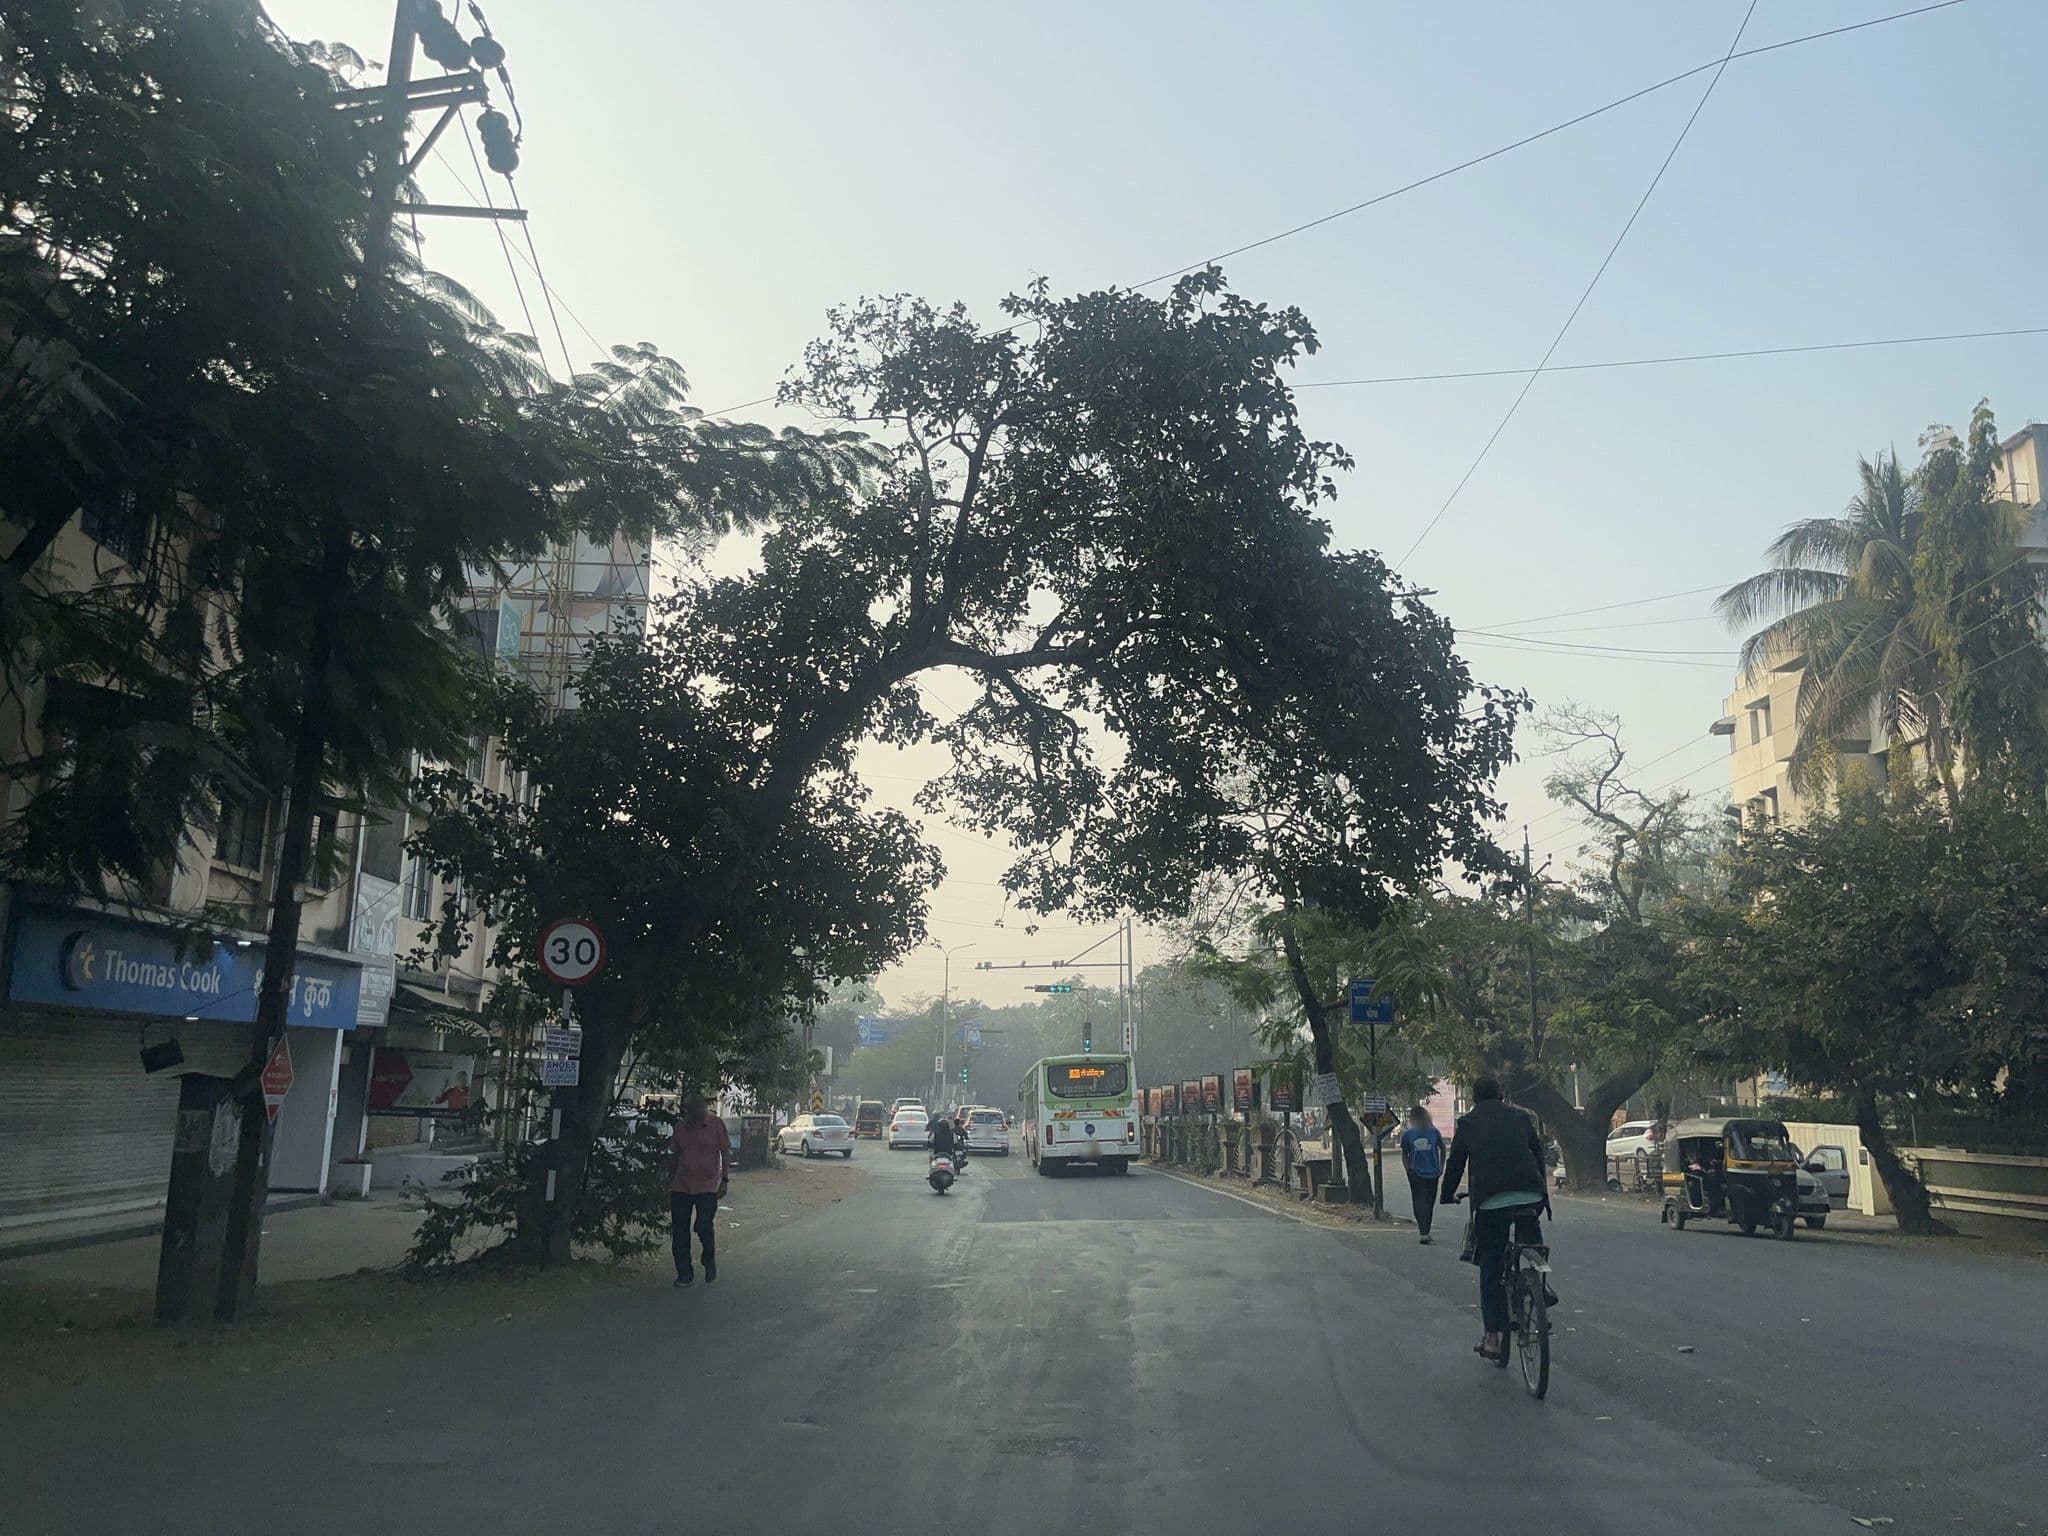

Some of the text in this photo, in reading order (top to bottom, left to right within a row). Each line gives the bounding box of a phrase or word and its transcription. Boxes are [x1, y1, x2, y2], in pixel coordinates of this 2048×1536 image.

[104, 949, 176, 989] Thomas
[180, 961, 222, 994] Cook
[550, 937, 596, 966] 30
[303, 977, 333, 1018] कुक
